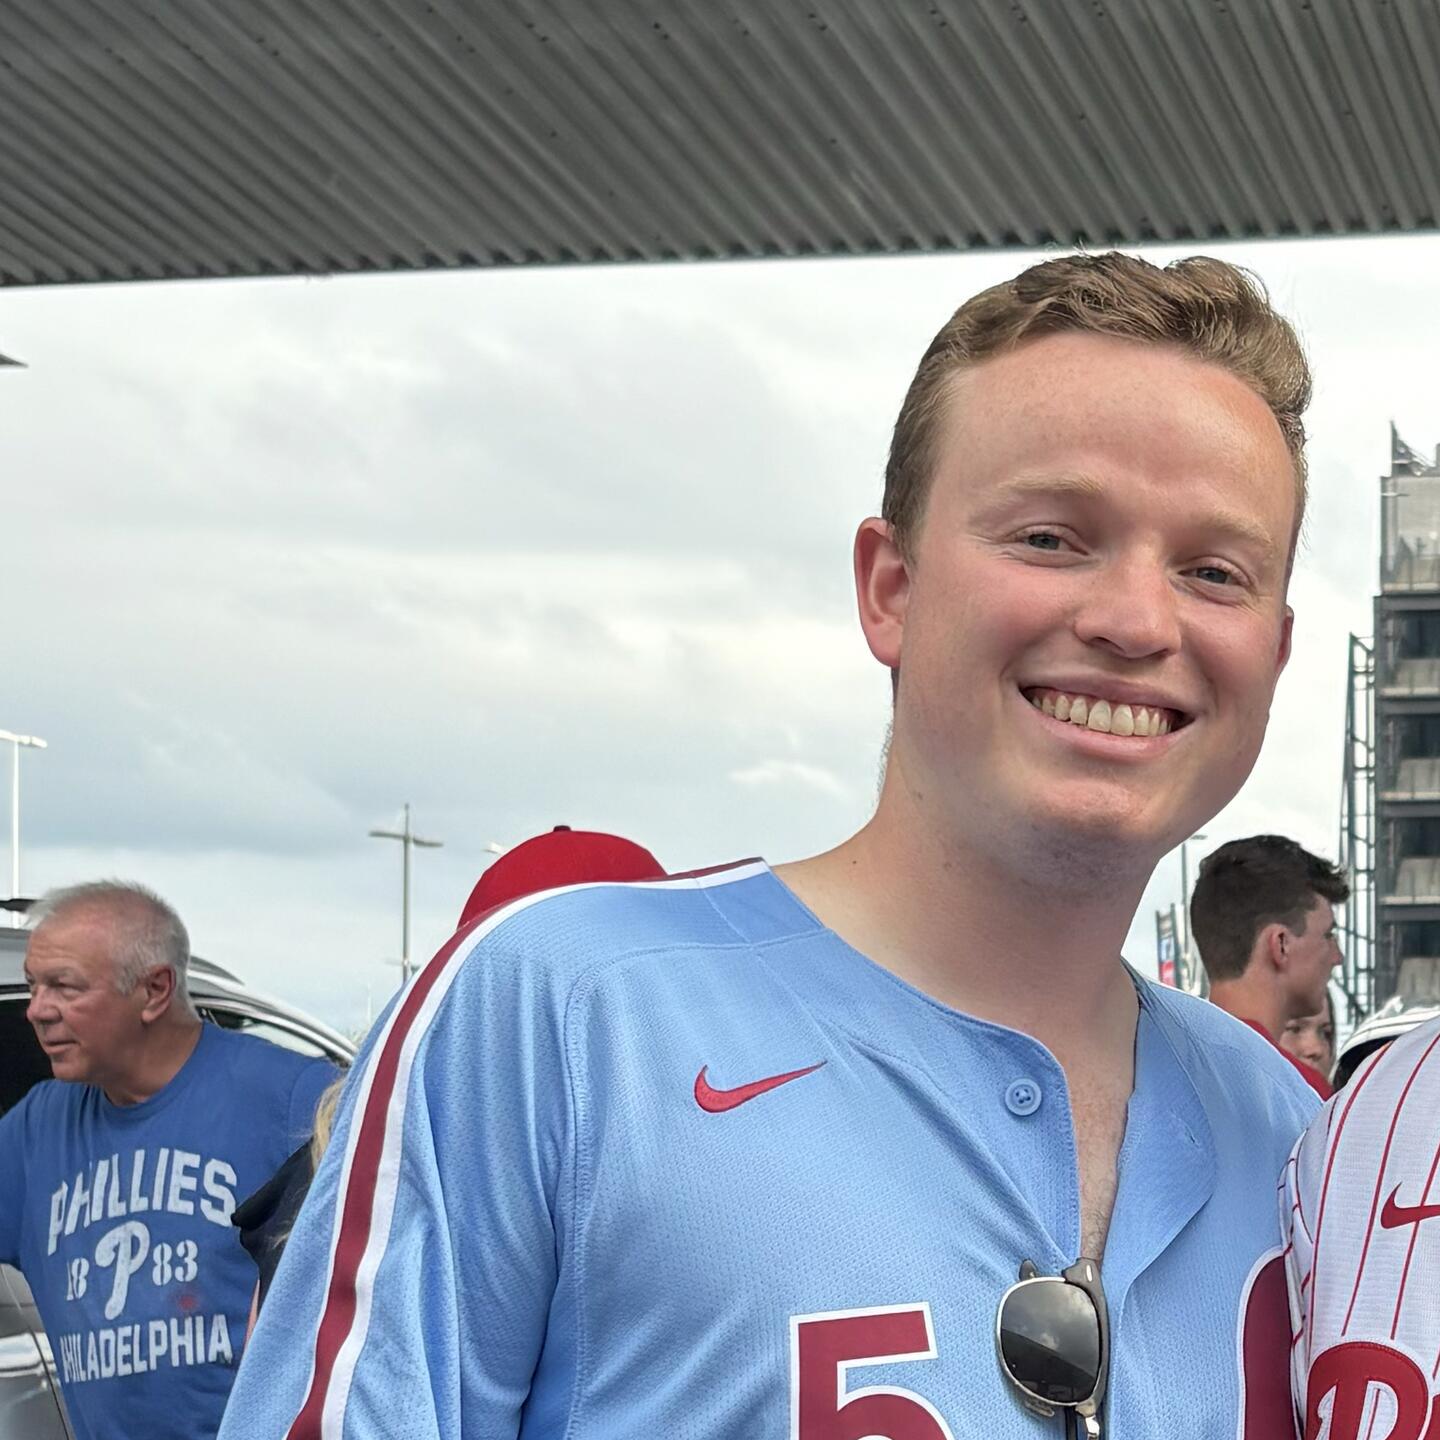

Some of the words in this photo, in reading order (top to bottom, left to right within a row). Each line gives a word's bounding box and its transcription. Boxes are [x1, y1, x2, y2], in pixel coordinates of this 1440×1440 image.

[48, 1148, 237, 1256] PHILLIES
[95, 1220, 150, 1320] P
[152, 1239, 199, 1286] 83
